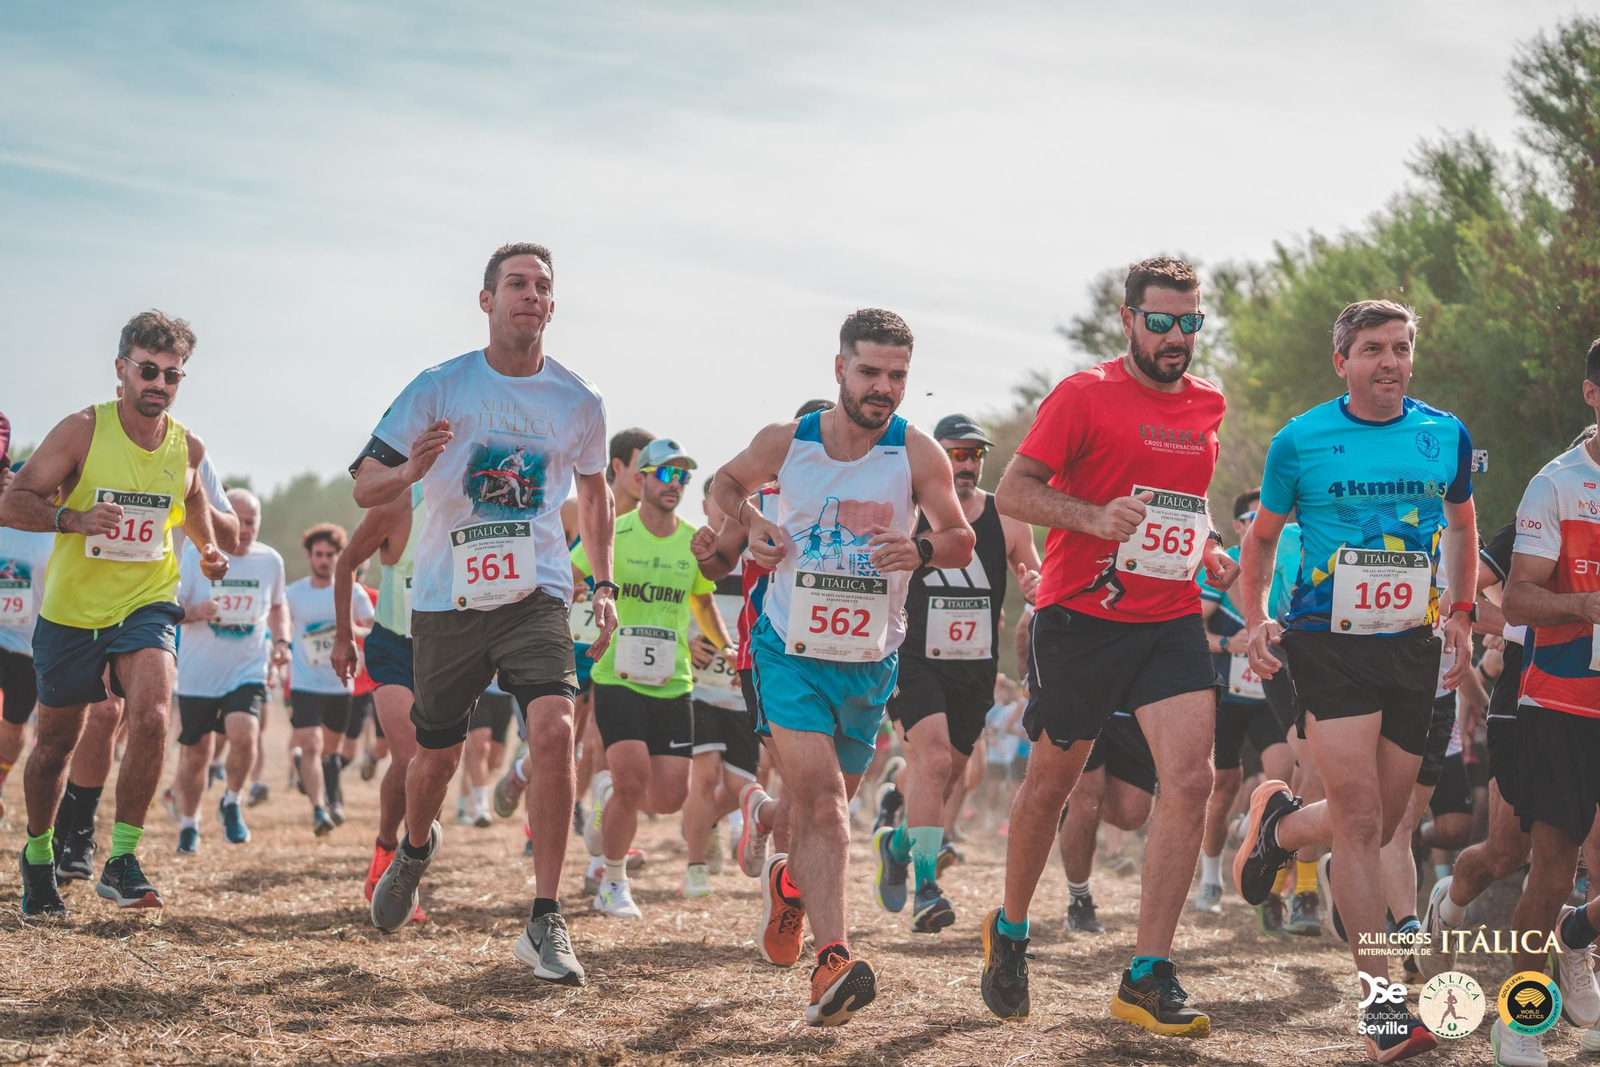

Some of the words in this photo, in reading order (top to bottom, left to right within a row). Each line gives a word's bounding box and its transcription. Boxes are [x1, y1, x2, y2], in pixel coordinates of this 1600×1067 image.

[1140, 424, 1208, 446] ITÁLICA
[1163, 442, 1206, 452] INTERNACIONAL
[468, 525, 509, 539] ITÁLICA
[1141, 522, 1196, 557] 563
[466, 552, 520, 585] 561
[1364, 552, 1407, 565] ITÁLICA
[821, 576, 866, 591] ITÁLICA
[222, 595, 254, 611] 377
[1354, 581, 1412, 610] 169
[809, 604, 871, 638] 562
[949, 620, 977, 641] 67
[643, 647, 655, 666] 5
